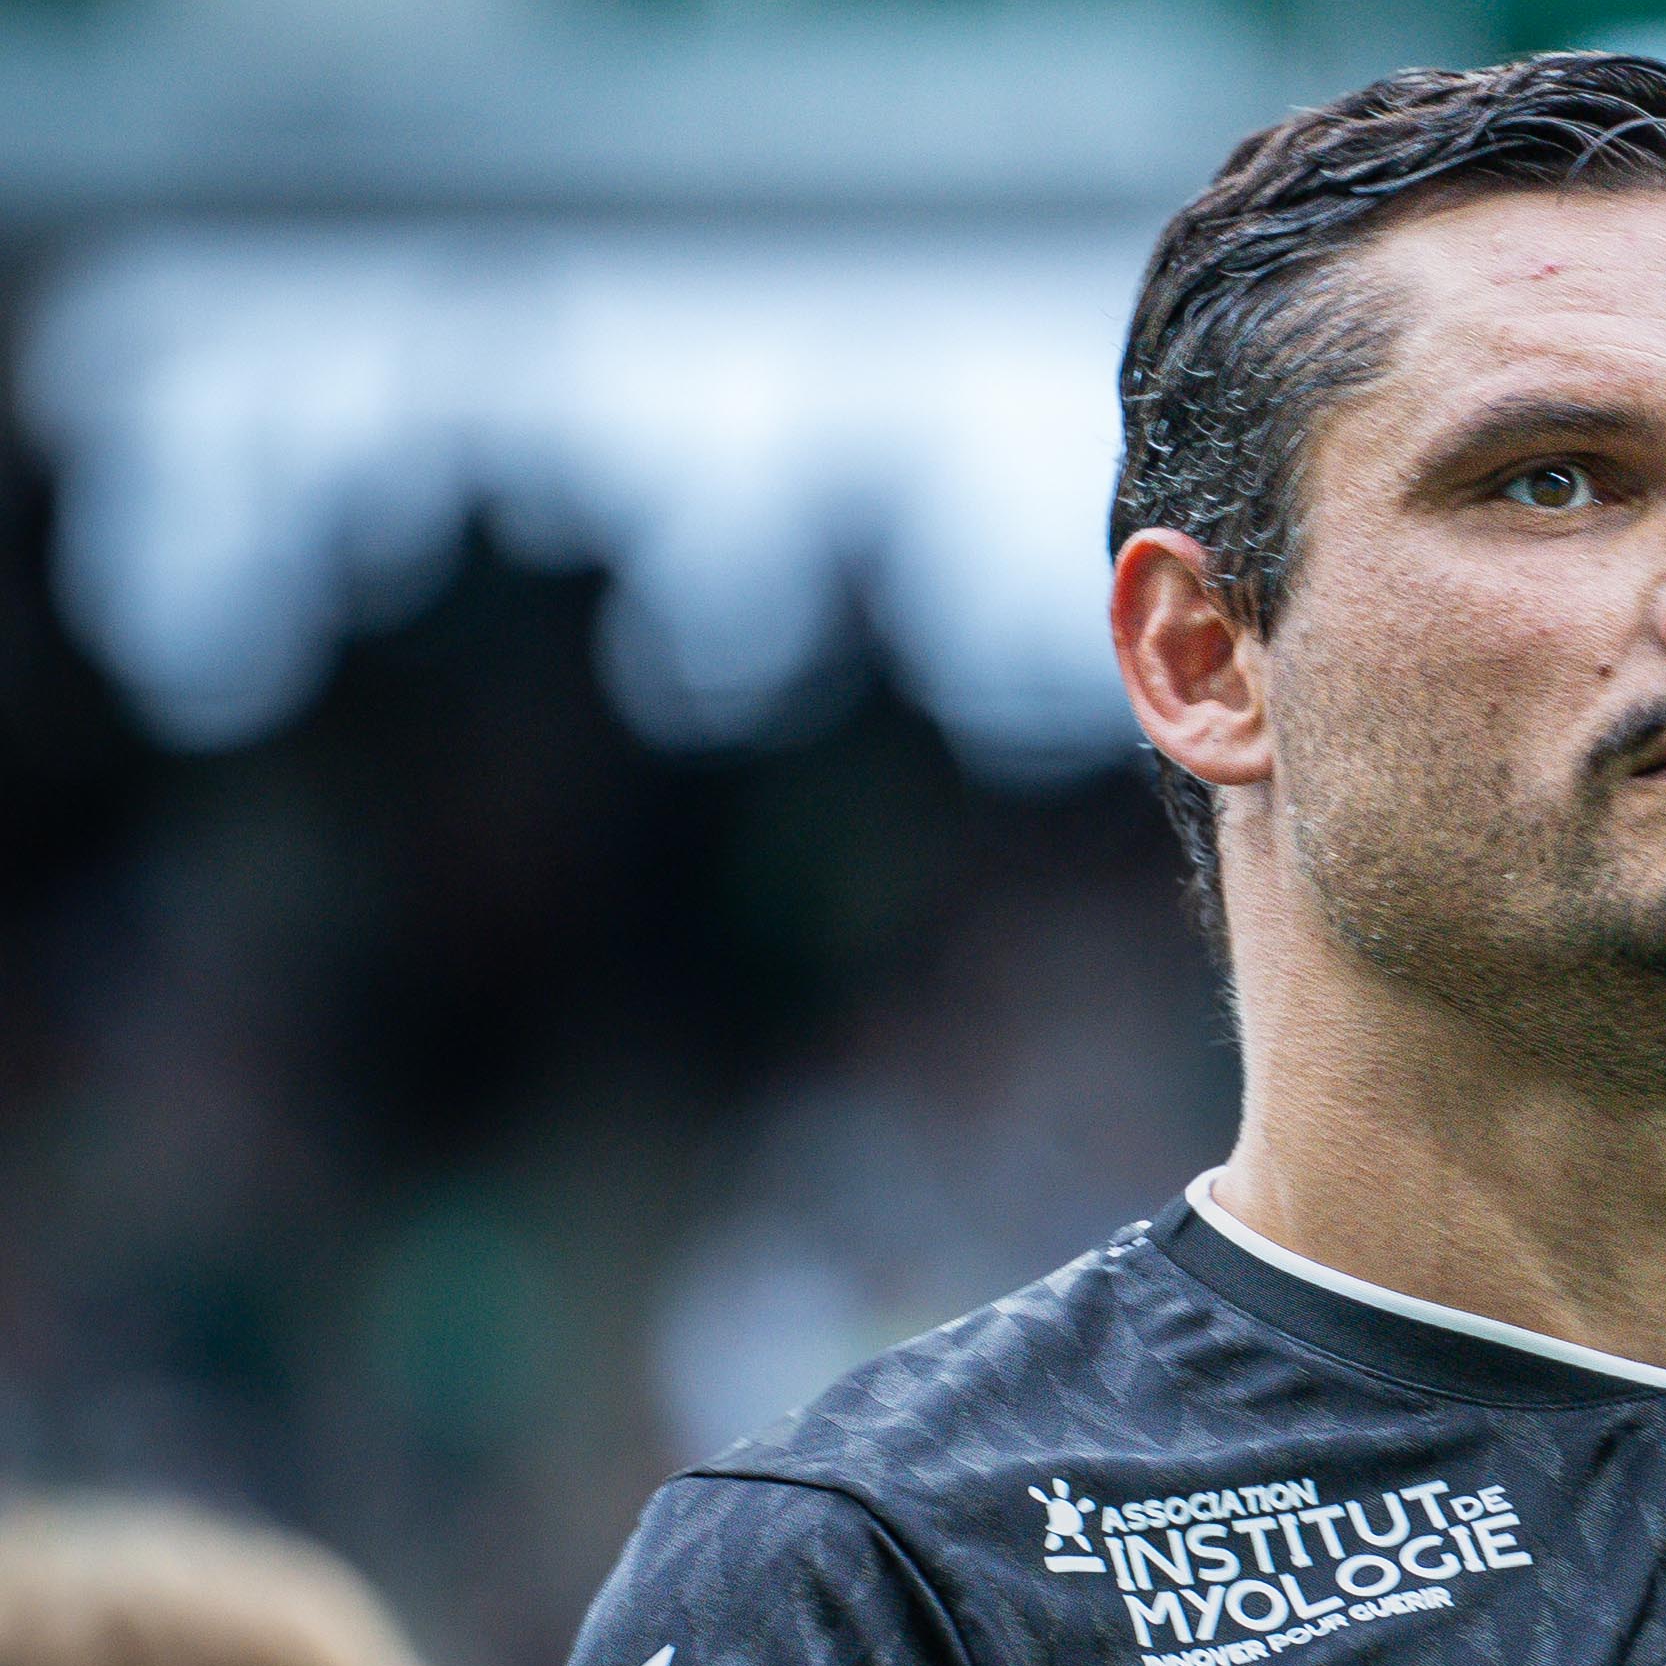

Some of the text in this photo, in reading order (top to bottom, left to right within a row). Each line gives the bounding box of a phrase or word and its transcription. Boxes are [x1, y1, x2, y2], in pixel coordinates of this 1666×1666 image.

[1101, 1478, 1319, 1533] ASSOCIATION
[1104, 1480, 1513, 1591] INSTITUT DE
[1122, 1513, 1533, 1648] MYOLOGIE
[1266, 1612, 1350, 1653] POUR
